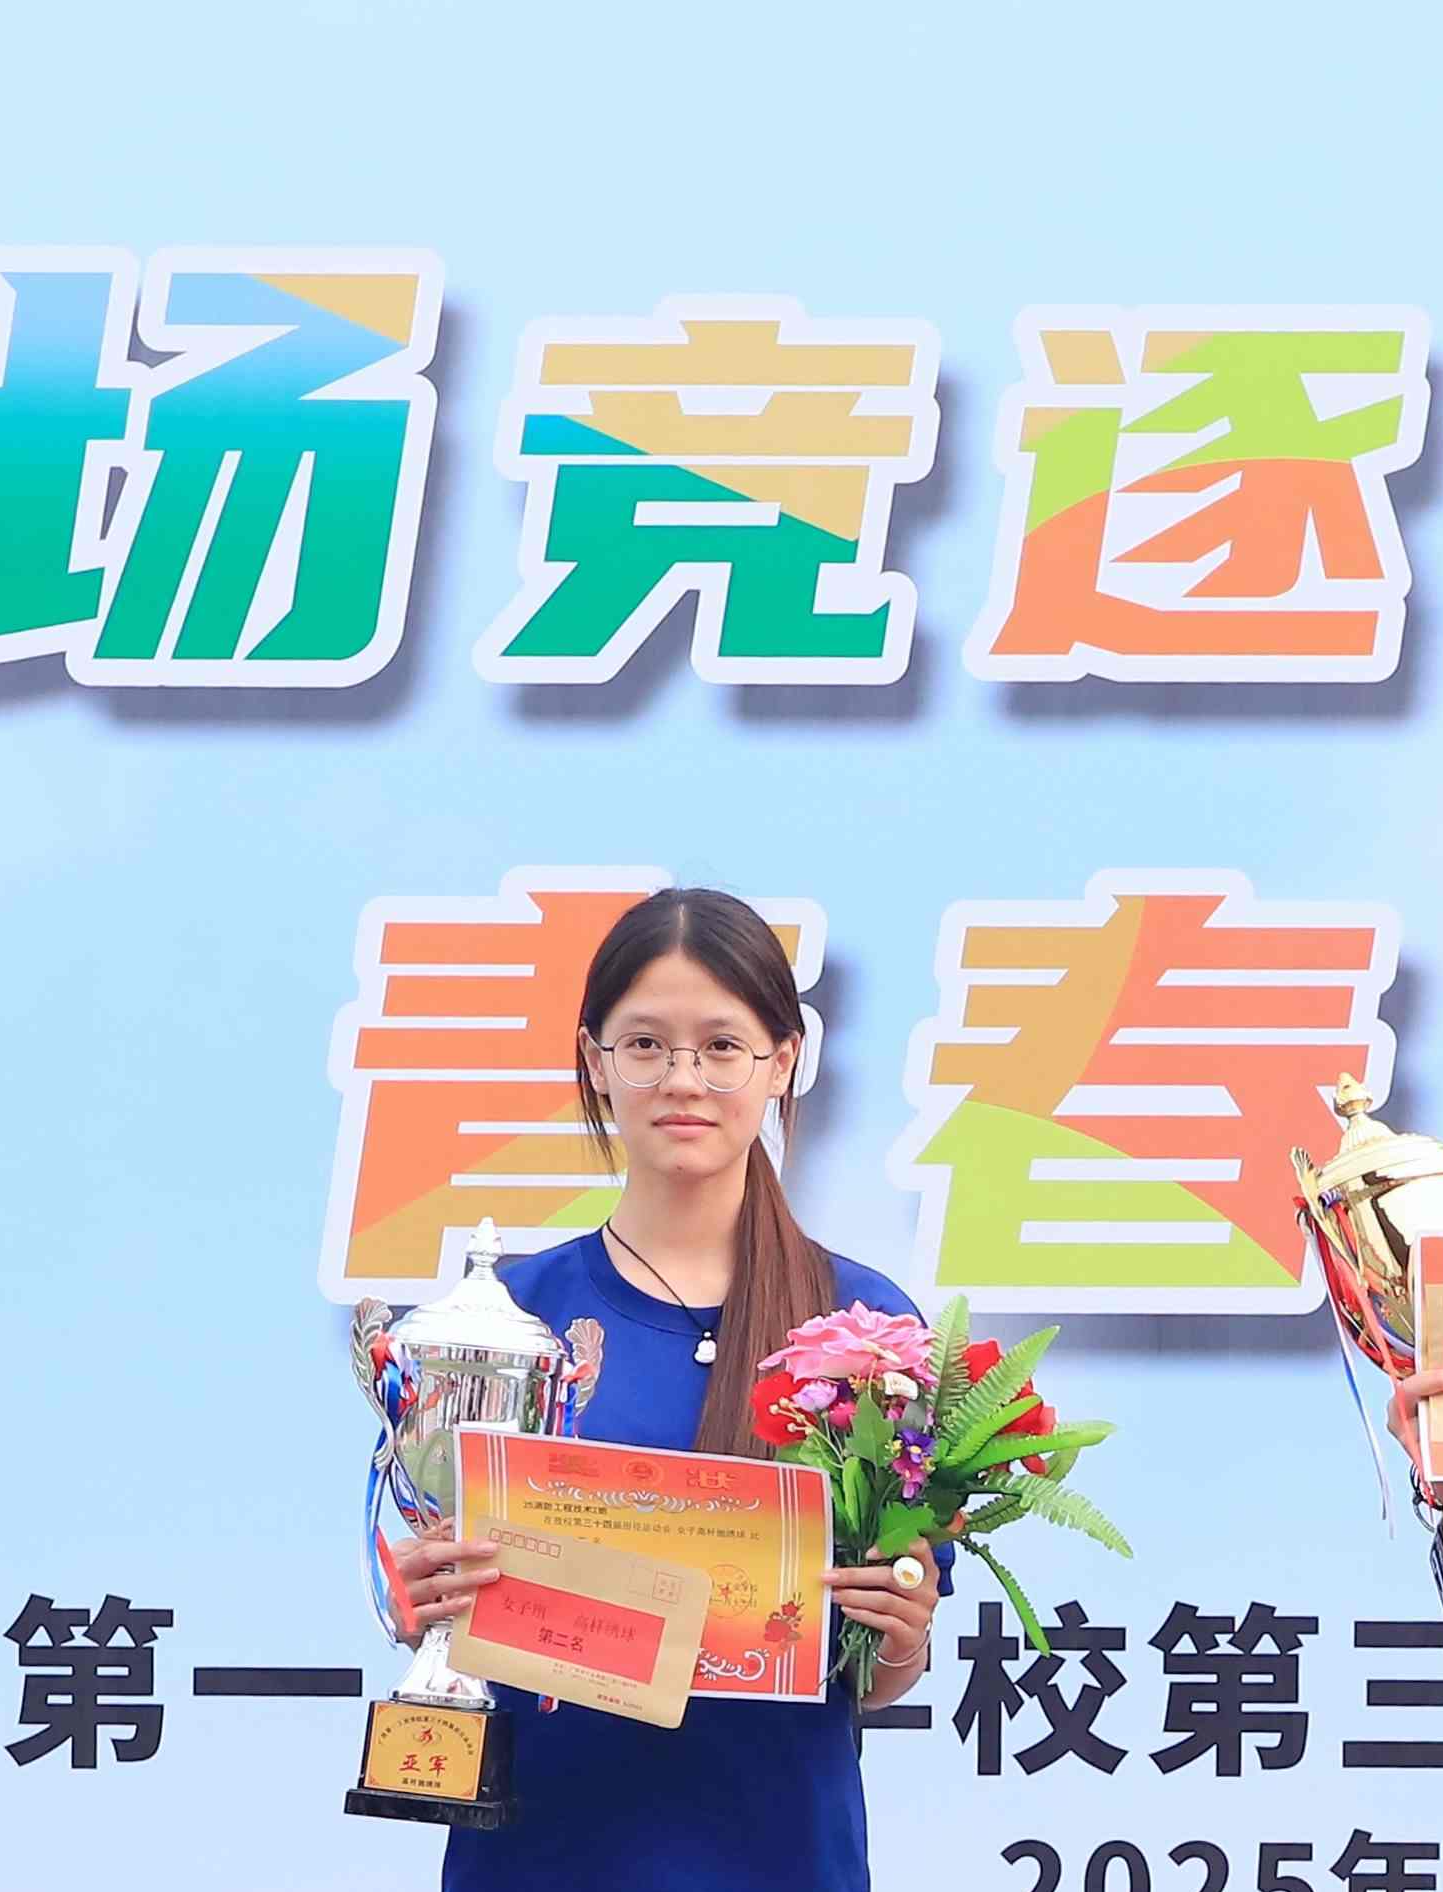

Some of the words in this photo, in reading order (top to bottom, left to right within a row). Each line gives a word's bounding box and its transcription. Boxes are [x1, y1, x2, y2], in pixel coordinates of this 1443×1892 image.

[538, 1626, 585, 1652] 第二名
[398, 1753, 449, 1779] 亚军
